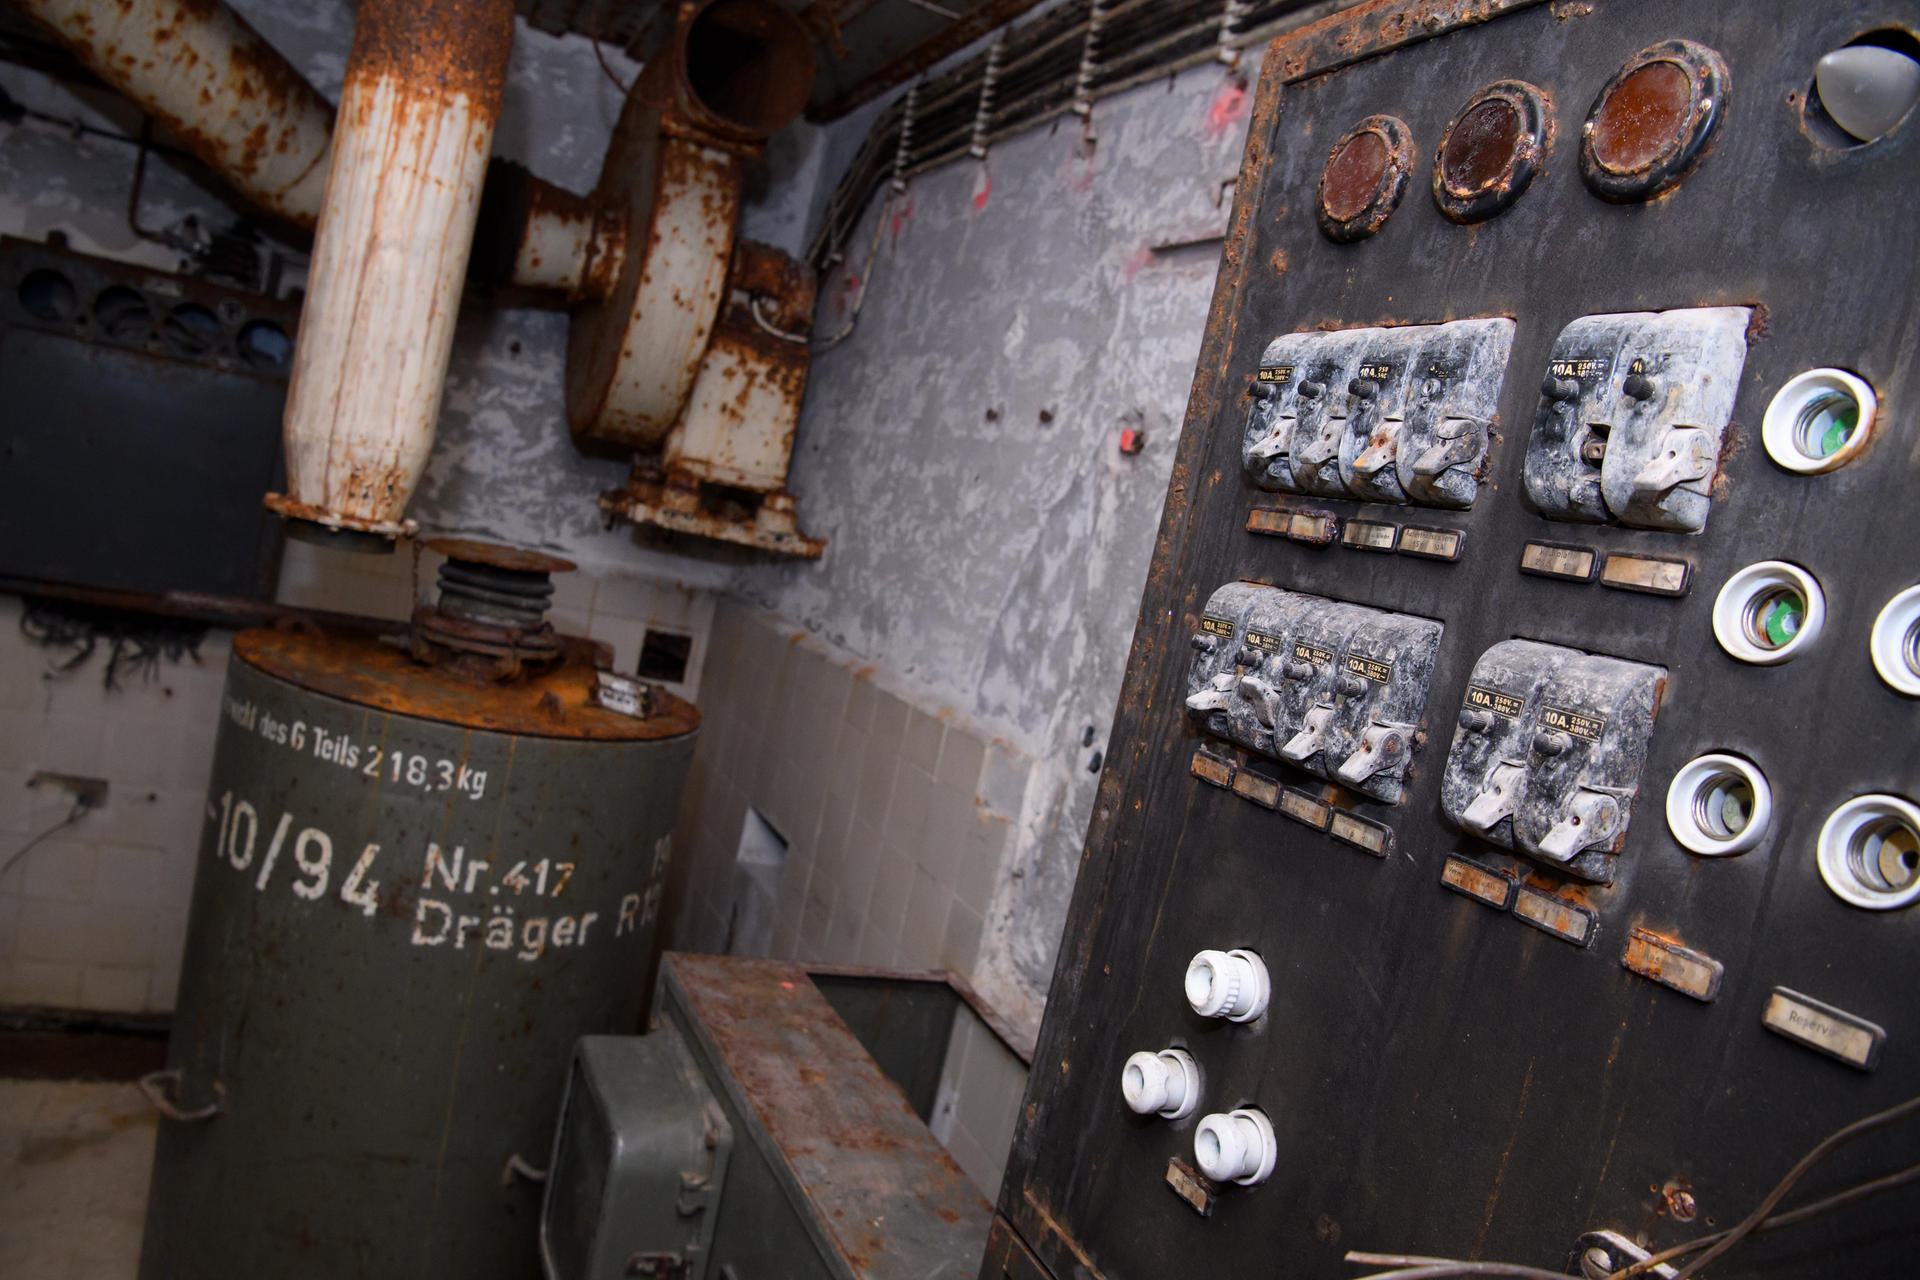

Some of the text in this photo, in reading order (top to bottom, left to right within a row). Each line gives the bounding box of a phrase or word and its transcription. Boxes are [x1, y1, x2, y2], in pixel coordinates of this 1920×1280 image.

[1471, 691, 1492, 707] 10A.
[1545, 712, 1569, 728] 10A.
[313, 726, 360, 768] Teils
[411, 898, 598, 962] Dräger
